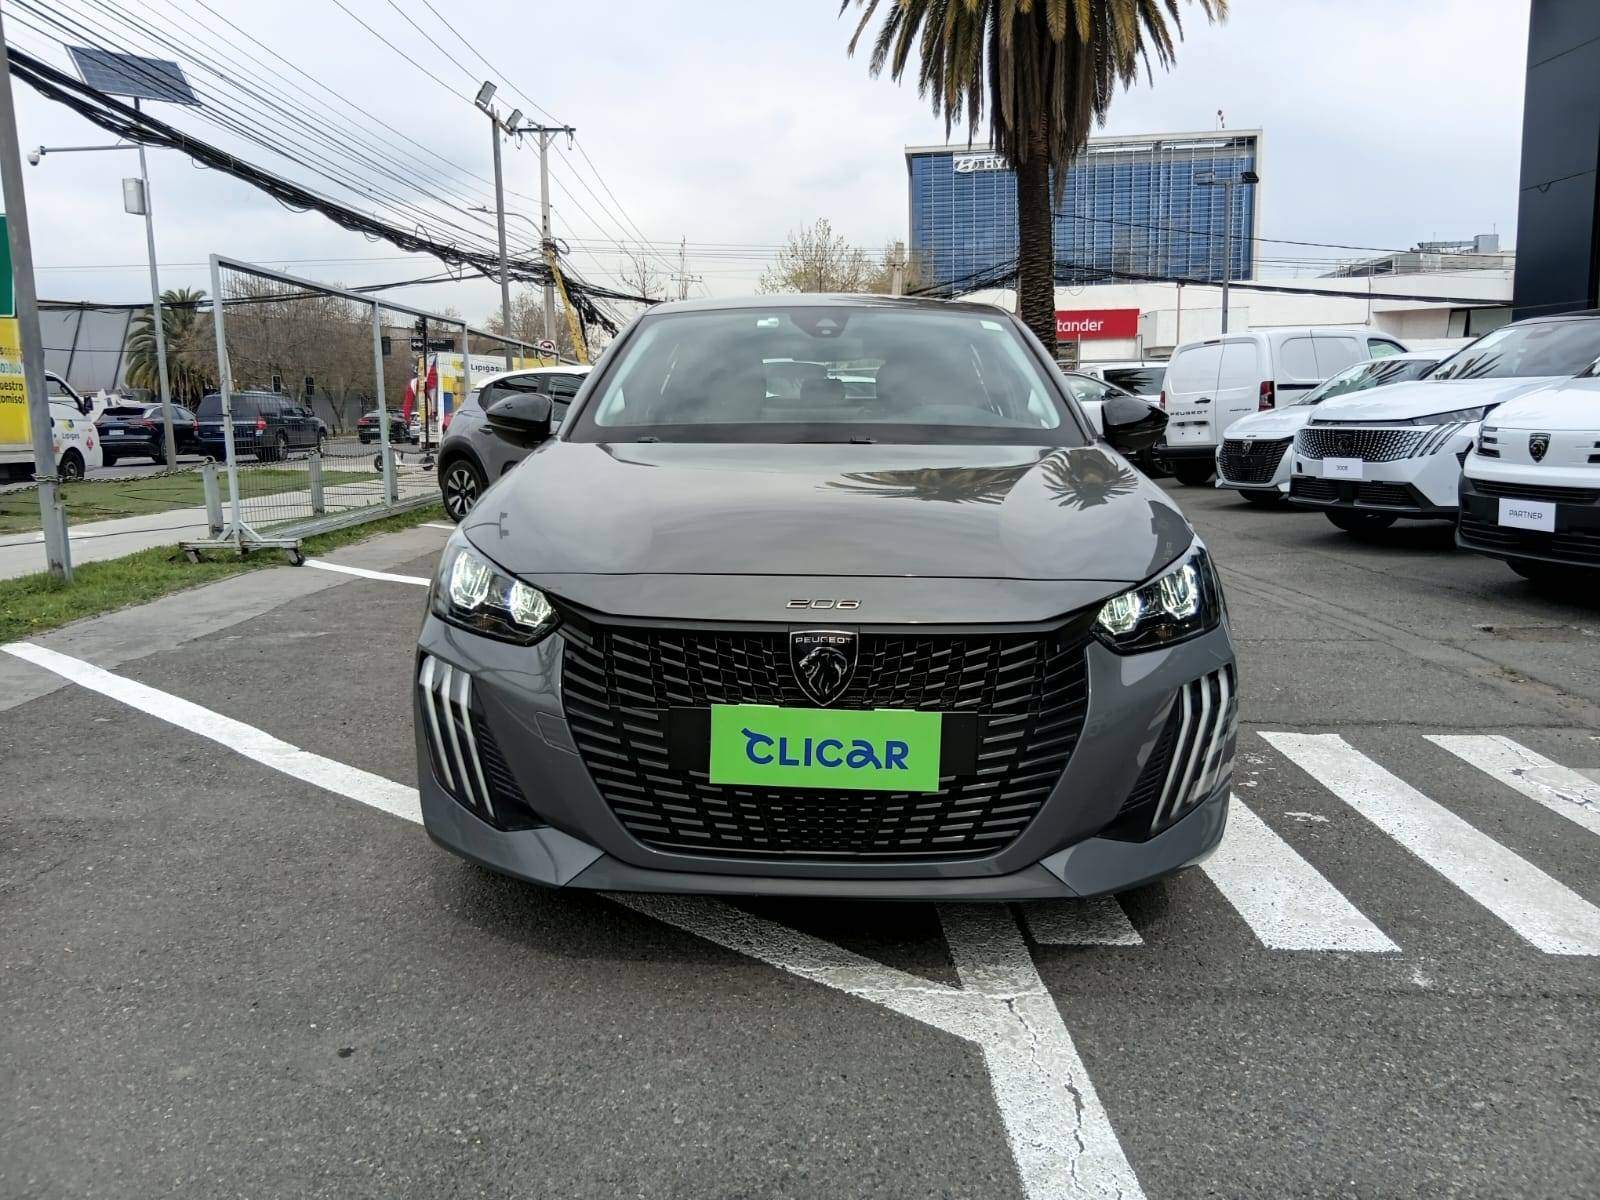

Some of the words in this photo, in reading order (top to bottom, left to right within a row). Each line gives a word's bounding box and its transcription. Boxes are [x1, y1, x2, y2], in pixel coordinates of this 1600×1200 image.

[1056, 319, 1104, 332] tander
[1509, 509, 1543, 521] PARTNER
[785, 599, 862, 610] 208
[795, 636, 853, 645] PEUGEOT
